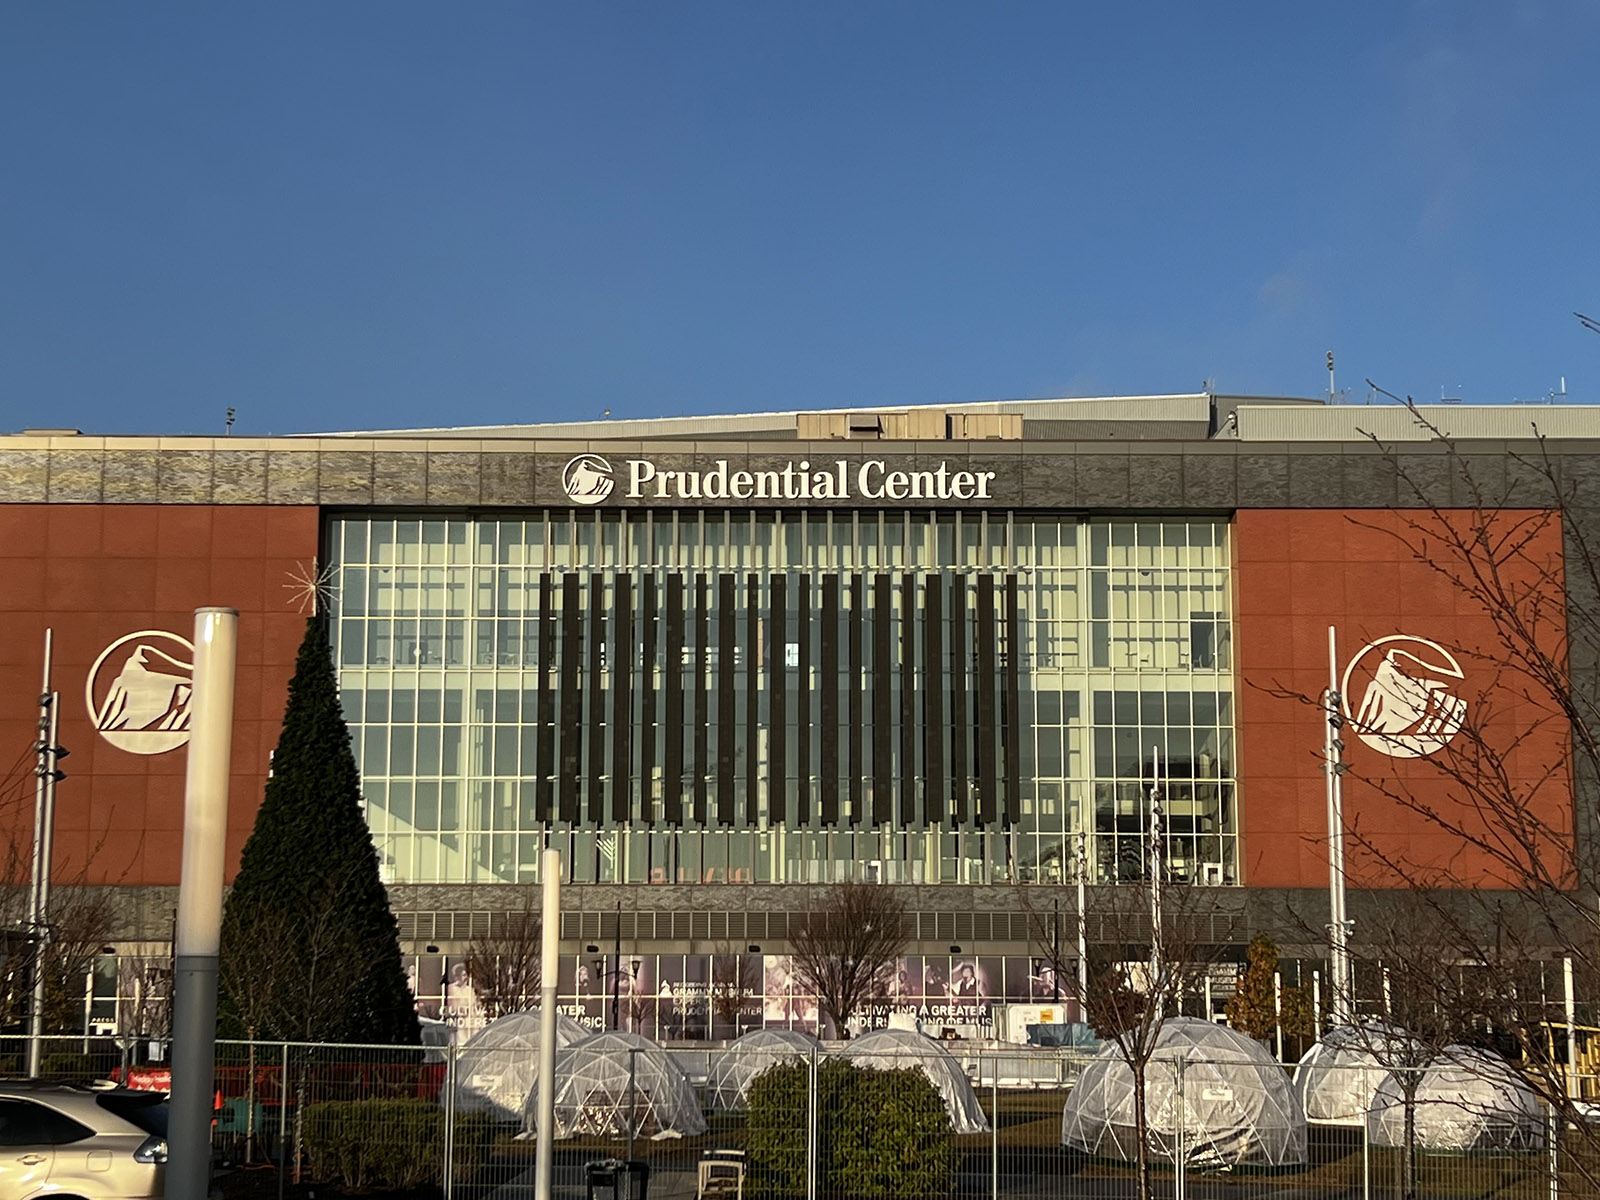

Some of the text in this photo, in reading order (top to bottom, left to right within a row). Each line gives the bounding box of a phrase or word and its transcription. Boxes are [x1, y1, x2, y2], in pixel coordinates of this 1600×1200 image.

[625, 459, 996, 500] Prudential Center
[673, 988, 712, 997] GRAMMY
[920, 1005, 929, 1016] A
[931, 1005, 987, 1016] GREATER
